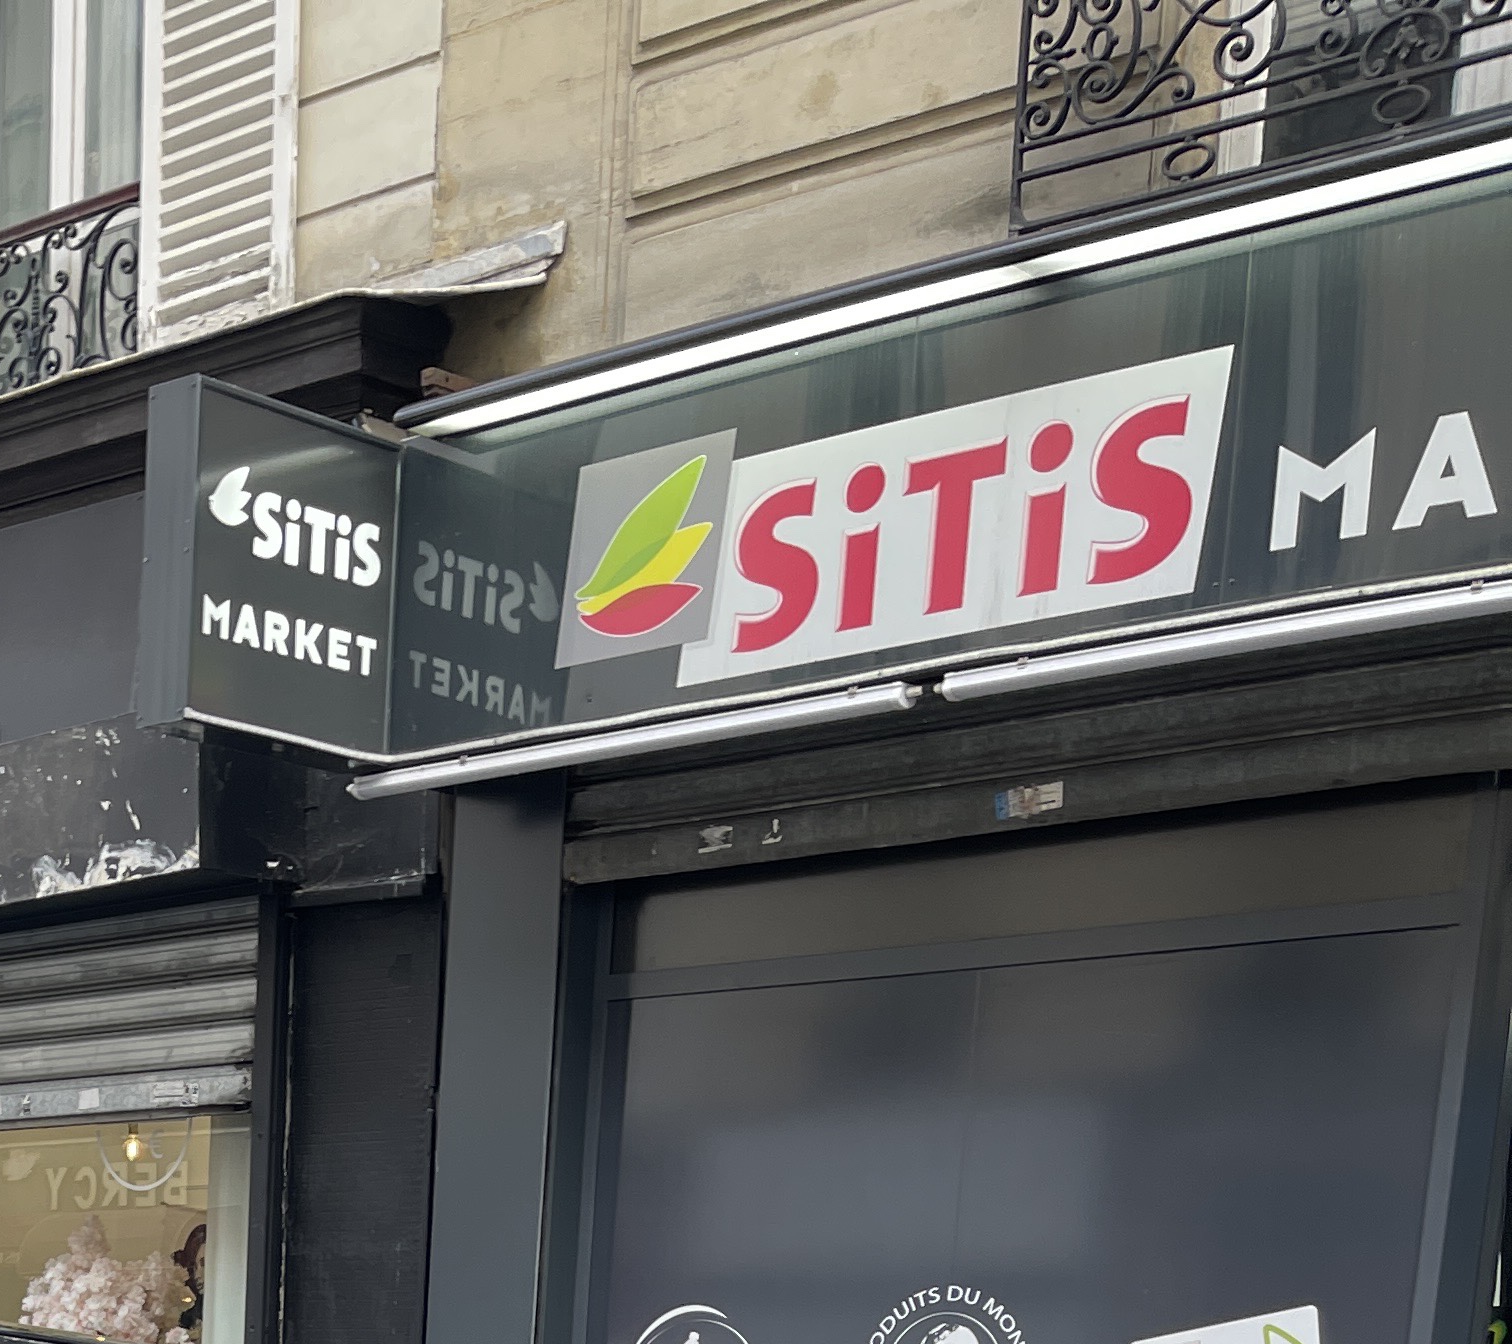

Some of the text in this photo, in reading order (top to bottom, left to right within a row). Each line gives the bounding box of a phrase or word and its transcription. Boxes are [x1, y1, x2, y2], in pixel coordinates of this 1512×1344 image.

[1268, 411, 1498, 552] MA
[201, 593, 378, 677] MARKET
[947, 1285, 981, 1305] DU
